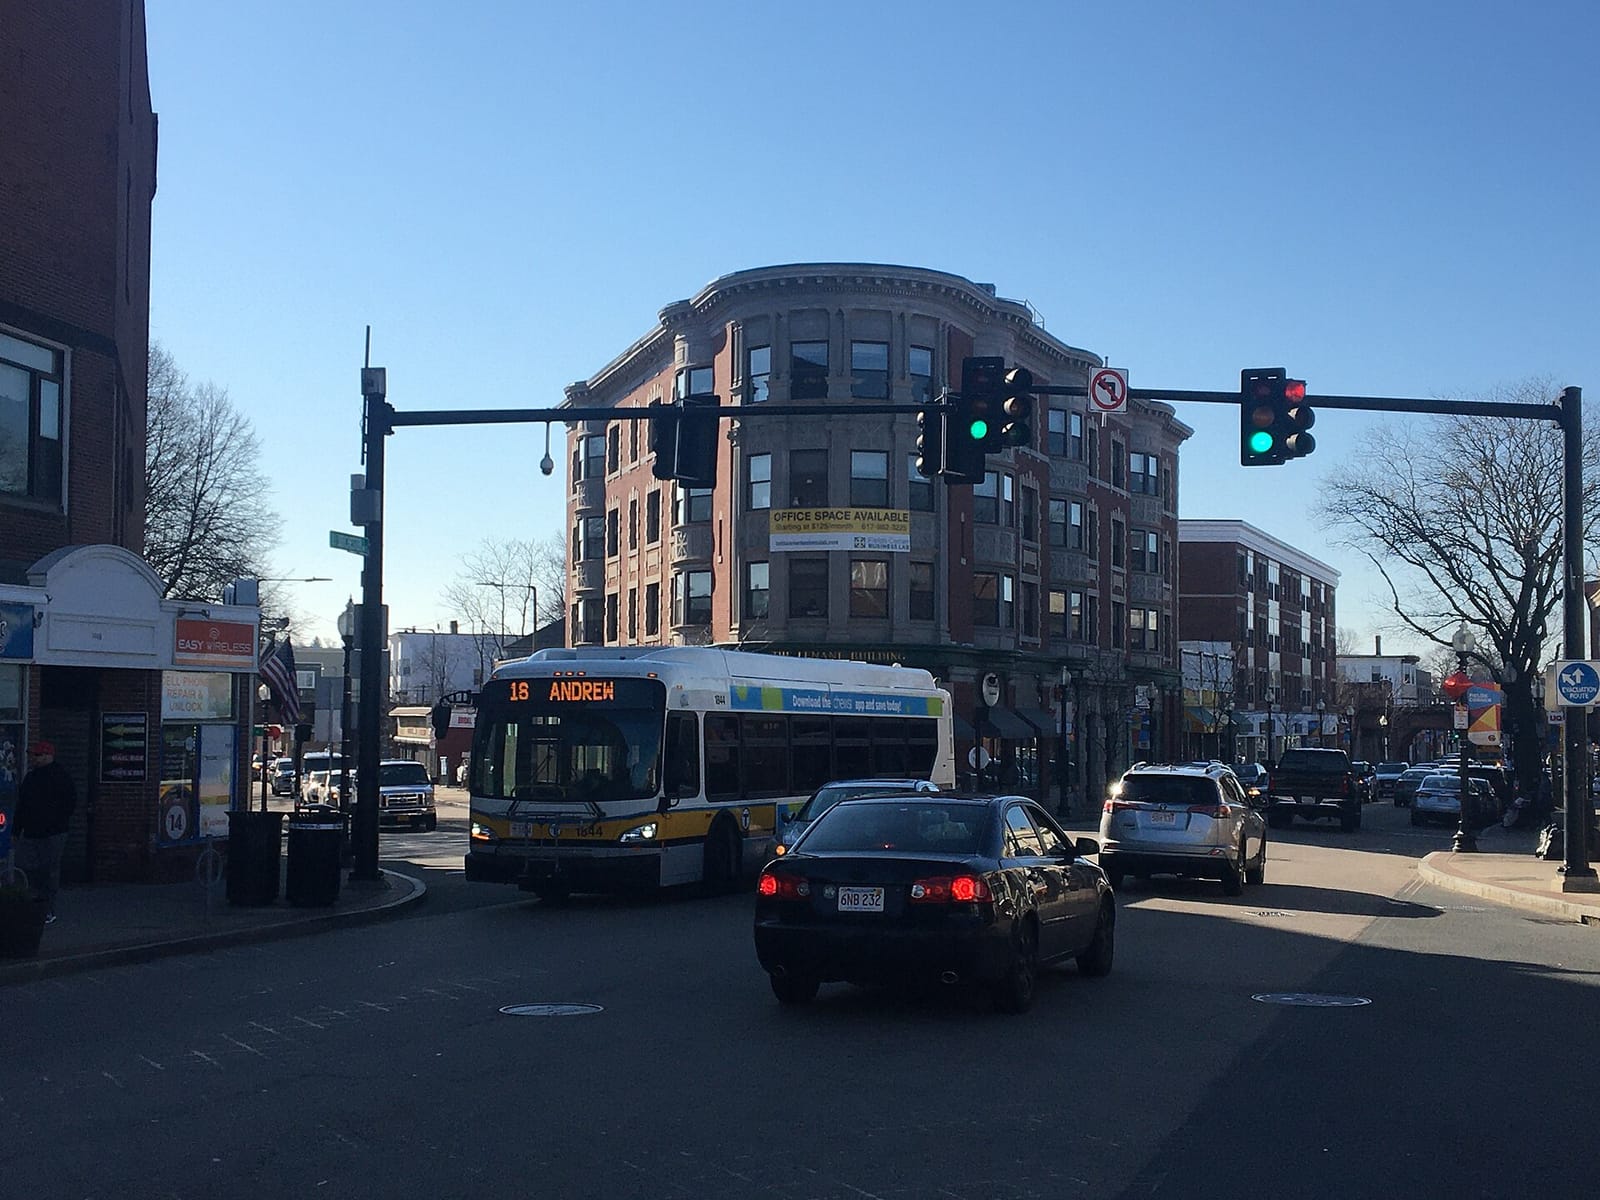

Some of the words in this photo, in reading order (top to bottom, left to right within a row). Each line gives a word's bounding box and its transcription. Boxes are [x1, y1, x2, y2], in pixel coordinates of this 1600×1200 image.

[774, 511, 811, 522] OFFICE
[814, 511, 851, 521] SPACE
[854, 511, 909, 522] AVAILABLE
[178, 639, 204, 650] EASY
[206, 641, 252, 653] WIRELESS
[549, 681, 615, 701] ANDREW
[169, 702, 204, 712] UNLOCK
[792, 694, 821, 708] Download
[822, 695, 832, 708] the
[866, 698, 875, 710] and
[169, 814, 183, 831] 14
[576, 826, 604, 838] 1844
[841, 893, 860, 906] 6NB
[862, 893, 881, 906] 232
